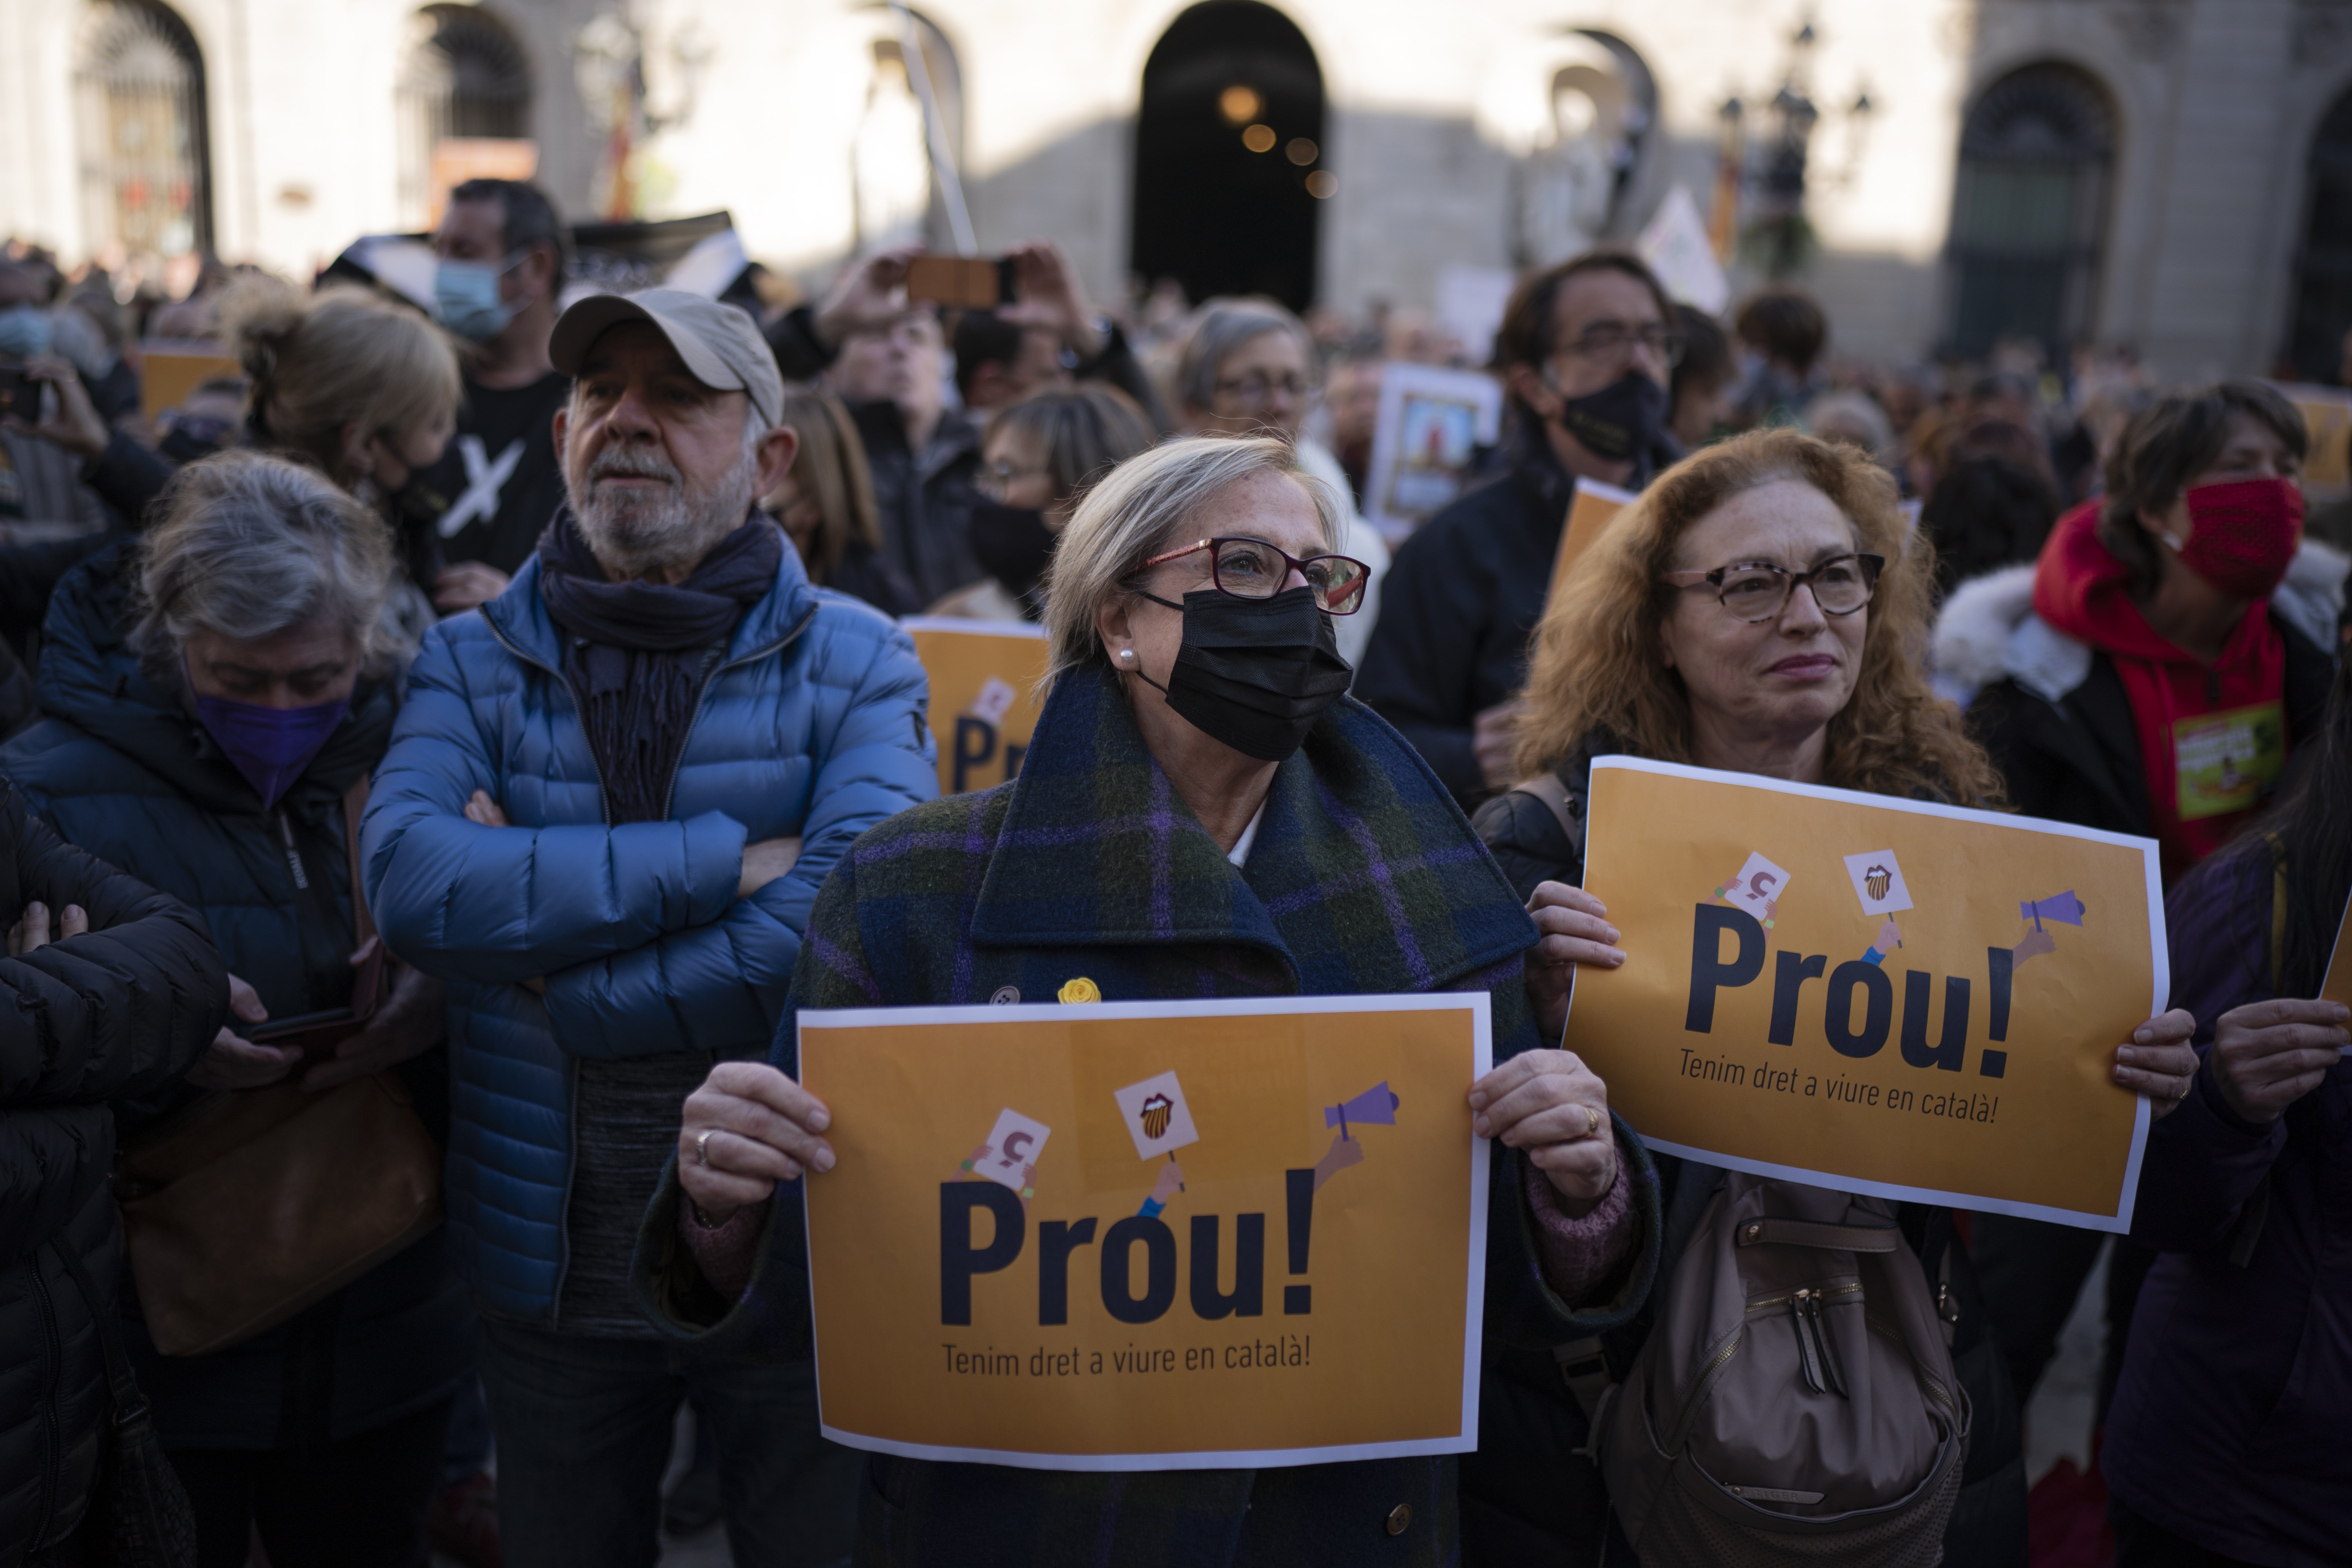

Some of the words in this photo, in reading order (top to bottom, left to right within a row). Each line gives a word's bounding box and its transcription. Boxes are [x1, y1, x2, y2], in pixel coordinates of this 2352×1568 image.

[1685, 903, 2013, 1079] Prou!
[1680, 1048, 1746, 1085] Tenim
[1753, 1061, 1798, 1094] dret
[1804, 1076, 1818, 1097] a
[1827, 1074, 1880, 1106] viure
[1887, 1089, 1914, 1112] en
[1921, 1091, 1999, 1124] català!
[940, 1169, 1315, 1326] Prou!
[941, 1343, 1019, 1377] Tenim
[1029, 1346, 1080, 1377] dret
[1089, 1351, 1103, 1375] a
[1112, 1343, 1176, 1374] viure
[1185, 1347, 1214, 1371] en
[1225, 1334, 1310, 1369] català!
[1755, 1490, 1798, 1502] TIGER
